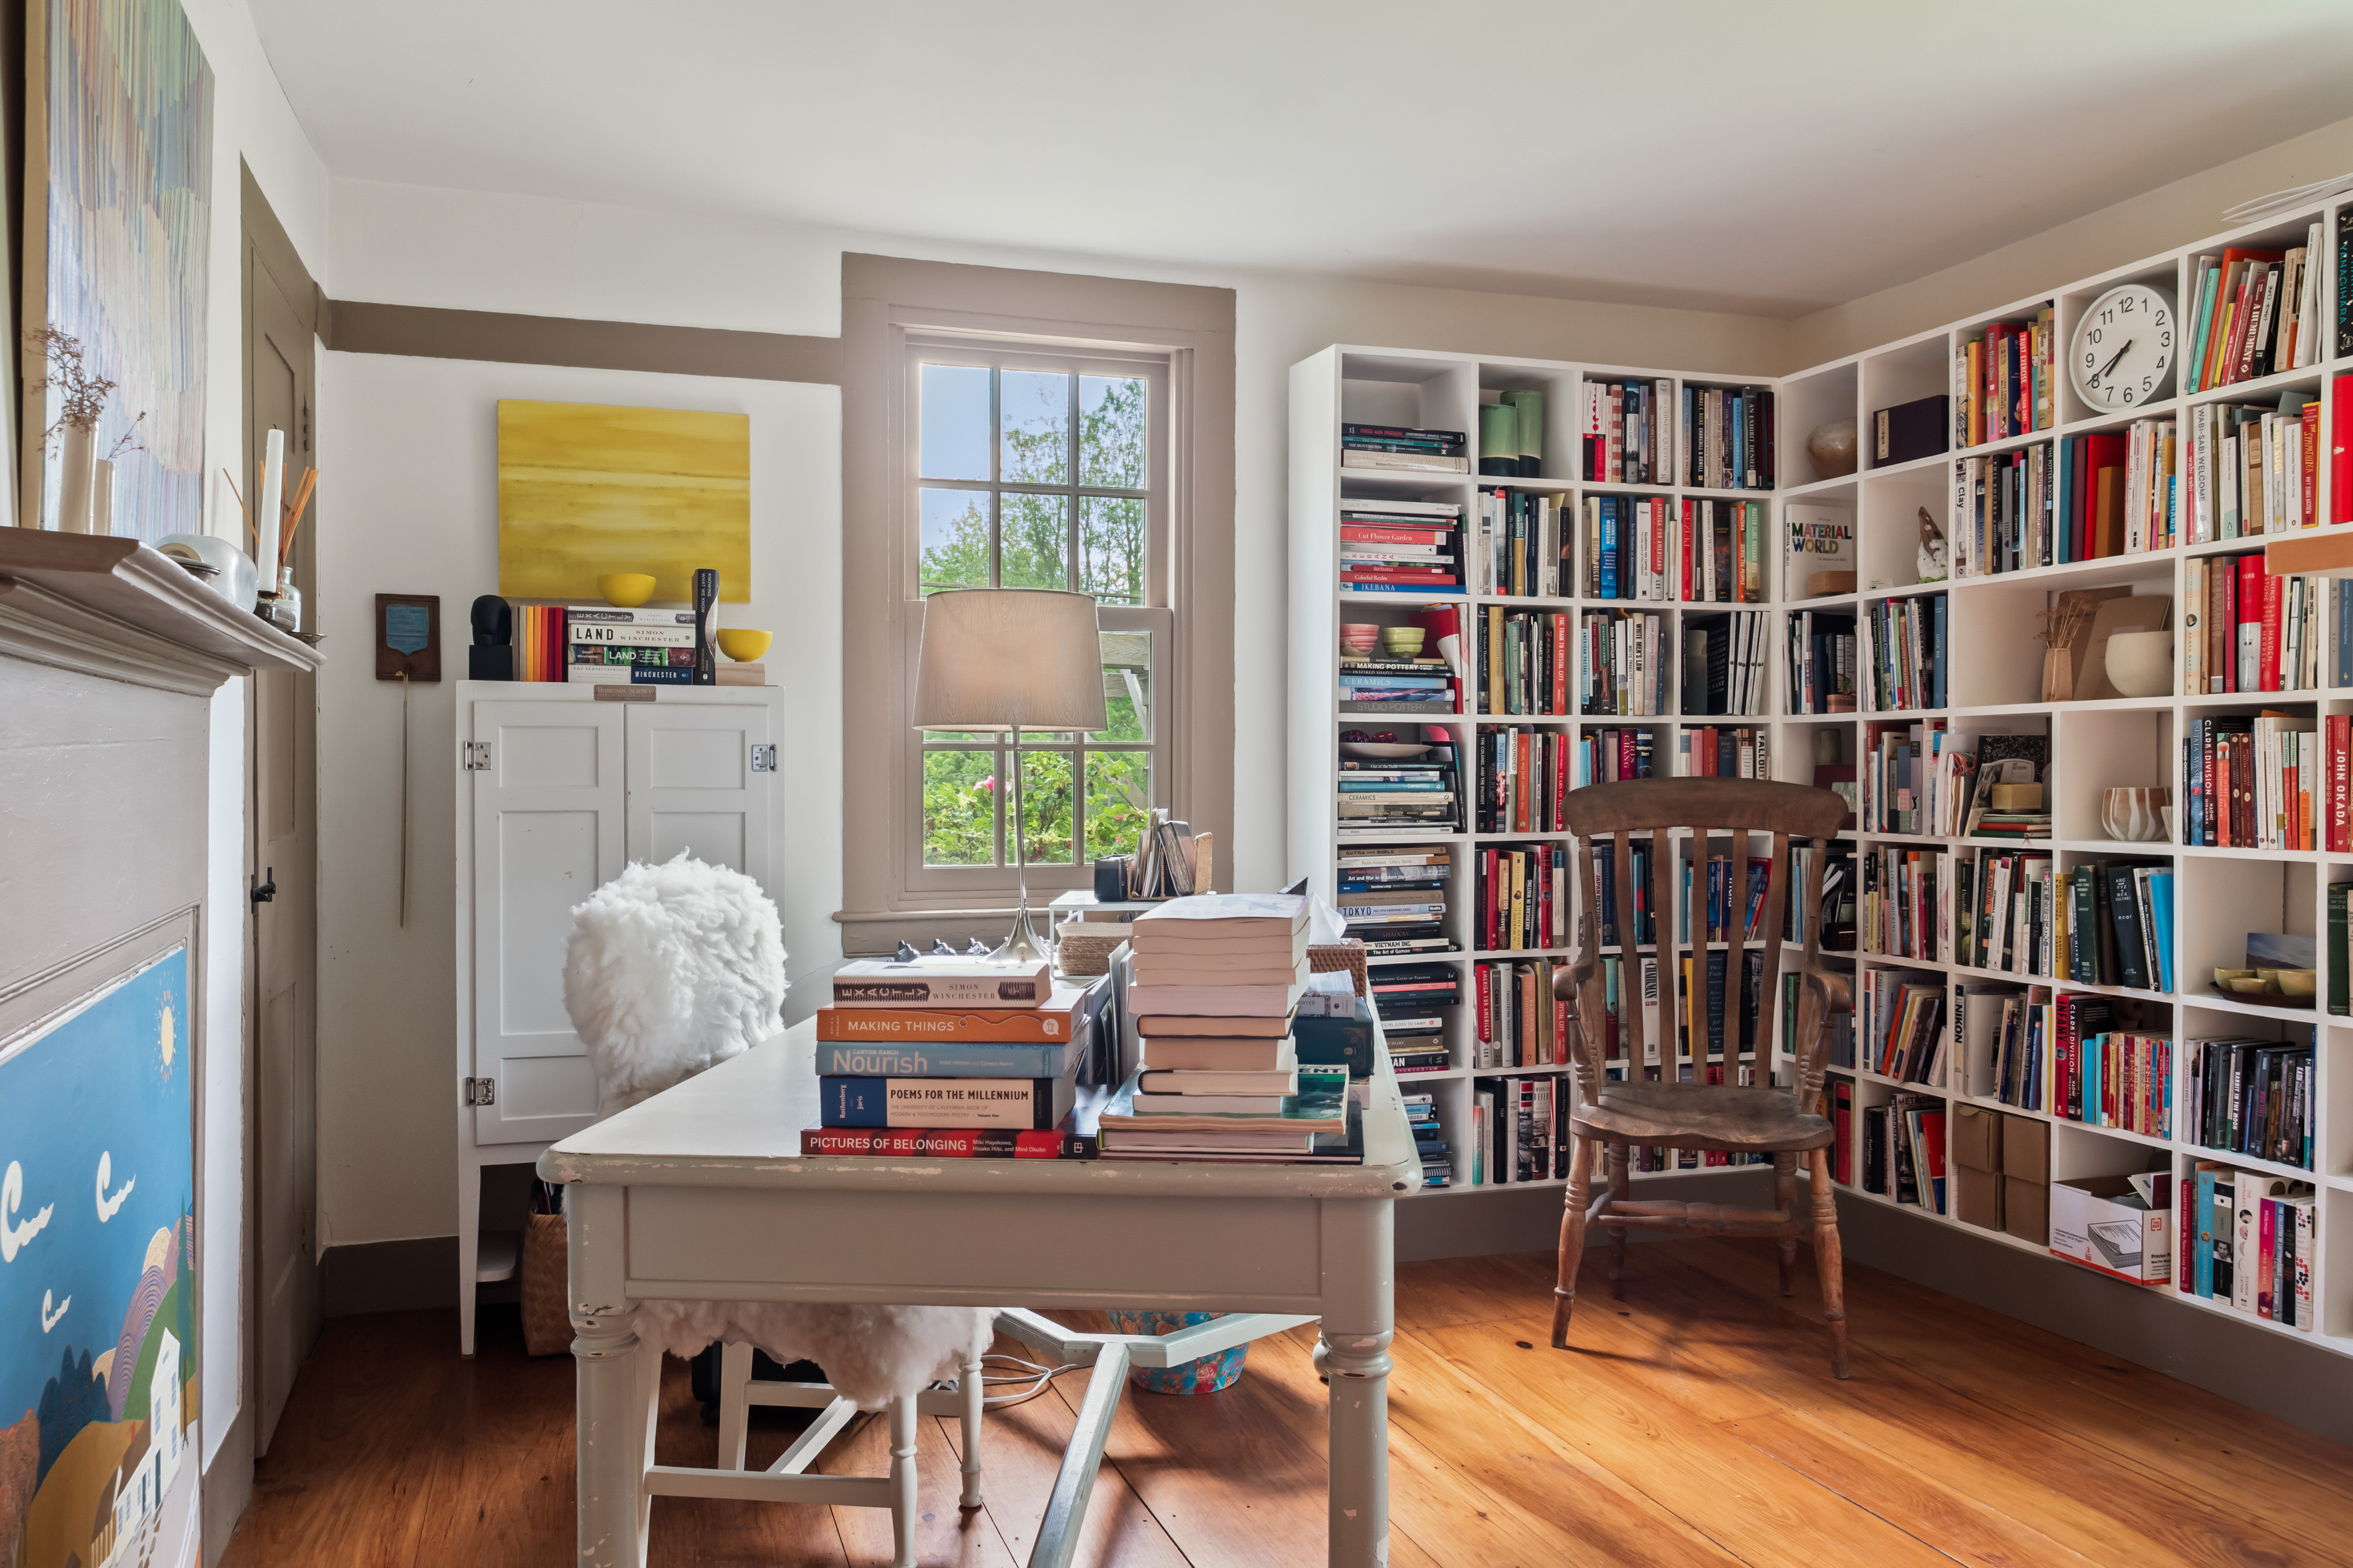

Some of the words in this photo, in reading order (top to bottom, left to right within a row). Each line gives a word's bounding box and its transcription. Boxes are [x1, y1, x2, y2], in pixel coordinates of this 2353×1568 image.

[2118, 296, 2134, 314] 12
[2141, 297, 2148, 313] 1
[2100, 308, 2113, 325] 11
[2155, 309, 2165, 327] 2
[2087, 328, 2102, 345] 10
[2161, 331, 2170, 347] 3
[2242, 311, 2260, 362] HUMUMENT
[2085, 353, 2095, 368] 9
[2156, 355, 2165, 369] 4
[2091, 373, 2100, 389] 8
[2142, 375, 2152, 392] 5
[2105, 386, 2114, 402] 7
[2123, 387, 2133, 403] 6
[1749, 403, 1754, 413] AN
[2304, 431, 2314, 474] SYMPATHIZER
[1957, 487, 1965, 508] Clay
[1792, 522, 1852, 539] MATERIAL
[1792, 538, 1838, 554] WORLD
[576, 628, 613, 640] LAND
[1357, 702, 1387, 710] STUDIO
[1390, 703, 1426, 711] POTTERY
[2336, 749, 2346, 780] JOHN
[2336, 785, 2345, 826] OKADA
[1343, 907, 1371, 916] TOKYO
[842, 988, 927, 997] EXACTLY
[848, 1021, 900, 1031] MAKING
[905, 1021, 954, 1031] THINGS
[833, 1049, 927, 1073] Nourish
[890, 1089, 922, 1099] POEMS
[925, 1090, 943, 1099] FOR
[946, 1090, 964, 1099] THE
[968, 1090, 1028, 1100] MILLENNIUM
[810, 1137, 869, 1148] PICTURES
[873, 1138, 890, 1149] OF
[894, 1139, 967, 1150] BELONGING
